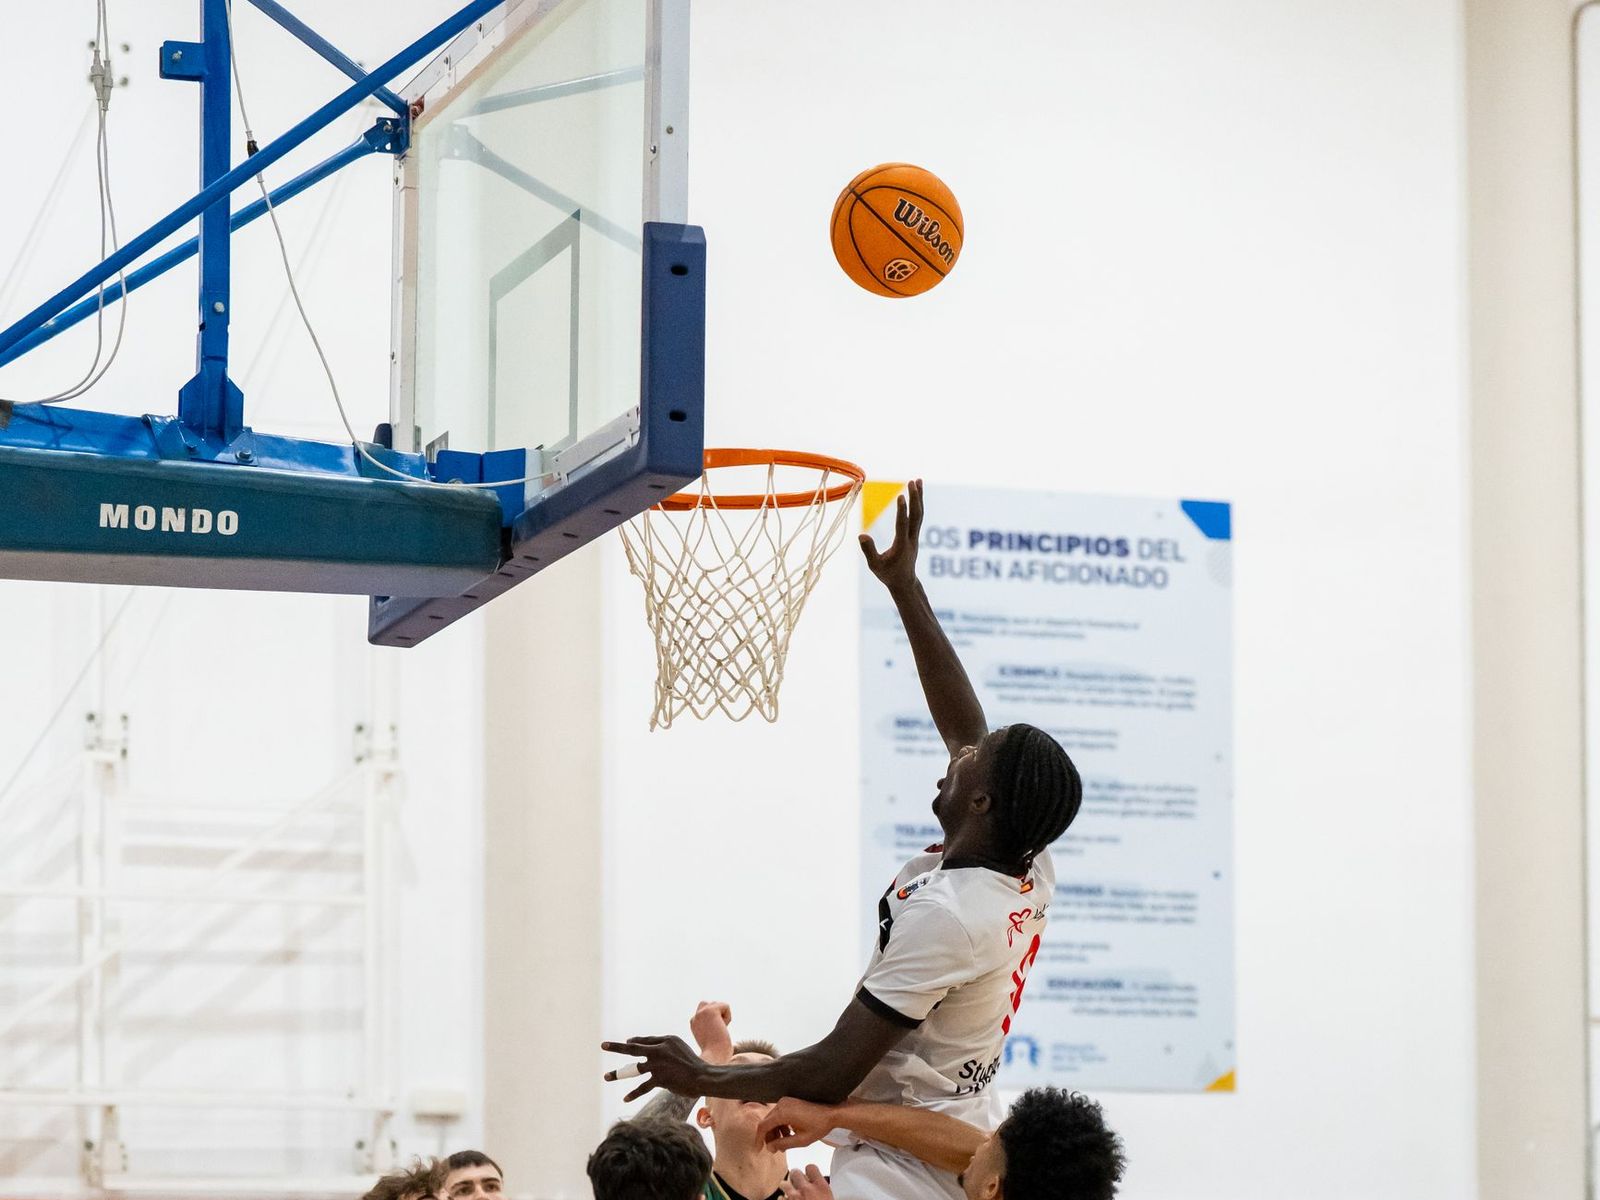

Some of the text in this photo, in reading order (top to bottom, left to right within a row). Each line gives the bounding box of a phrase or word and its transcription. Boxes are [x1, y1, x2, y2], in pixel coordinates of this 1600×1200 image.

[894, 198, 955, 266] Wilson
[99, 503, 239, 536] MONDO
[968, 530, 1129, 557] PRINCIPIOS
[1137, 538, 1186, 562] DEL
[929, 556, 1168, 589] BUEN AFICIONADO
